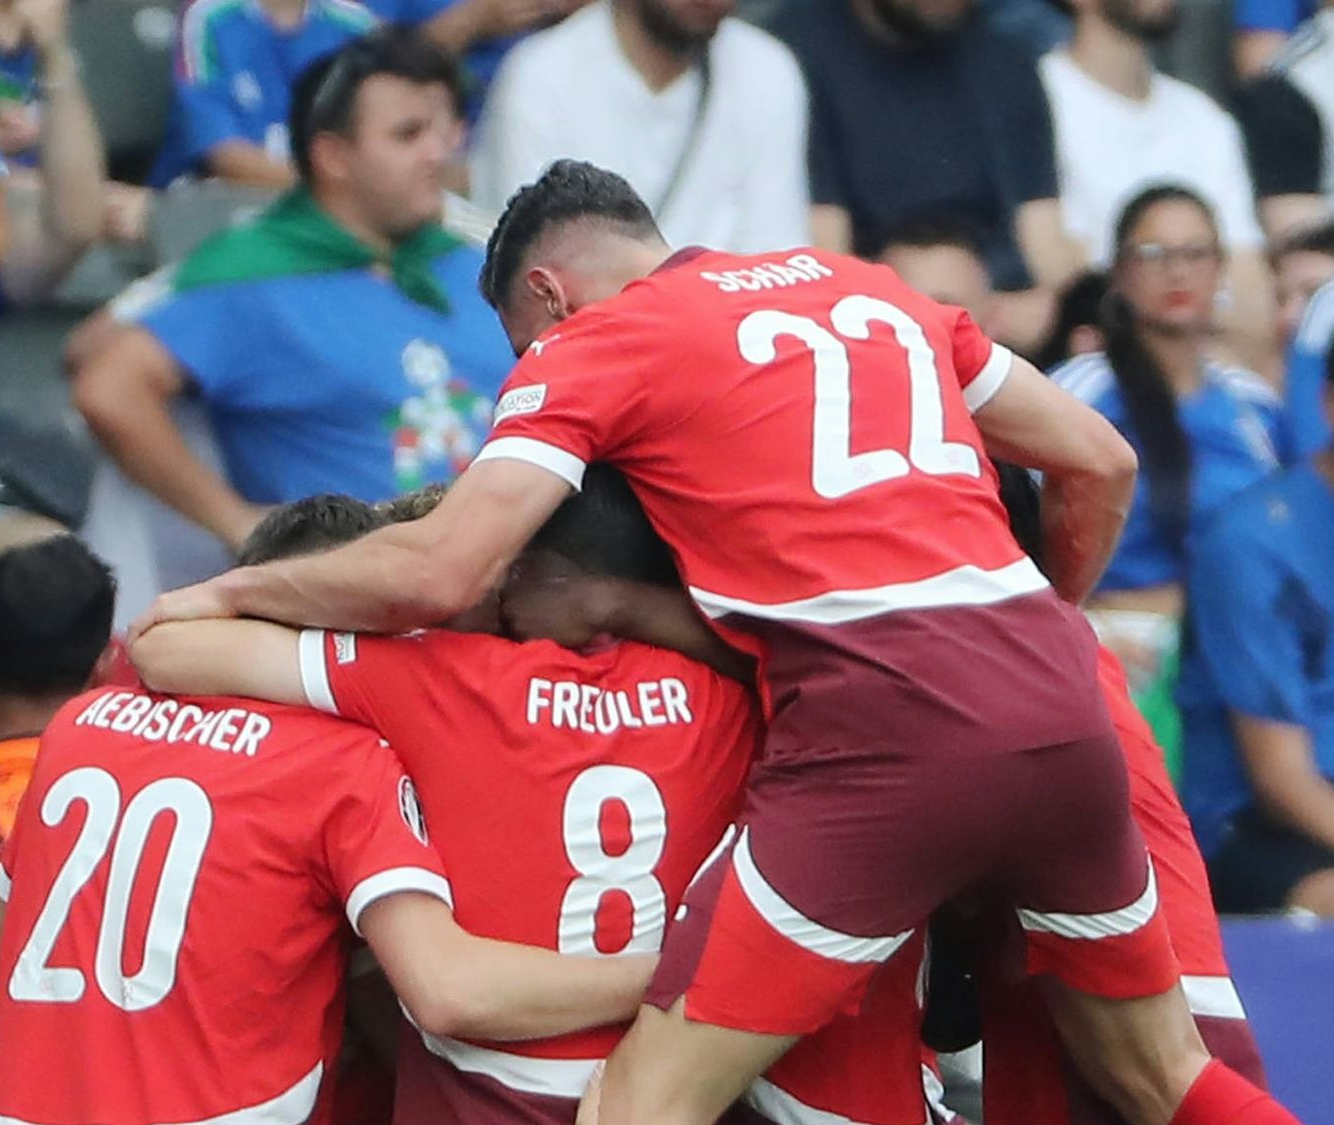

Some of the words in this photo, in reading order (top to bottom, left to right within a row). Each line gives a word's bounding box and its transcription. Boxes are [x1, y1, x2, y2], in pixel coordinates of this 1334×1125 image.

[737, 294, 981, 499] 22
[76, 692, 271, 756] AEBISCHER
[526, 677, 694, 735] FREULER
[8, 766, 213, 1011] 20
[557, 763, 667, 956] 8
